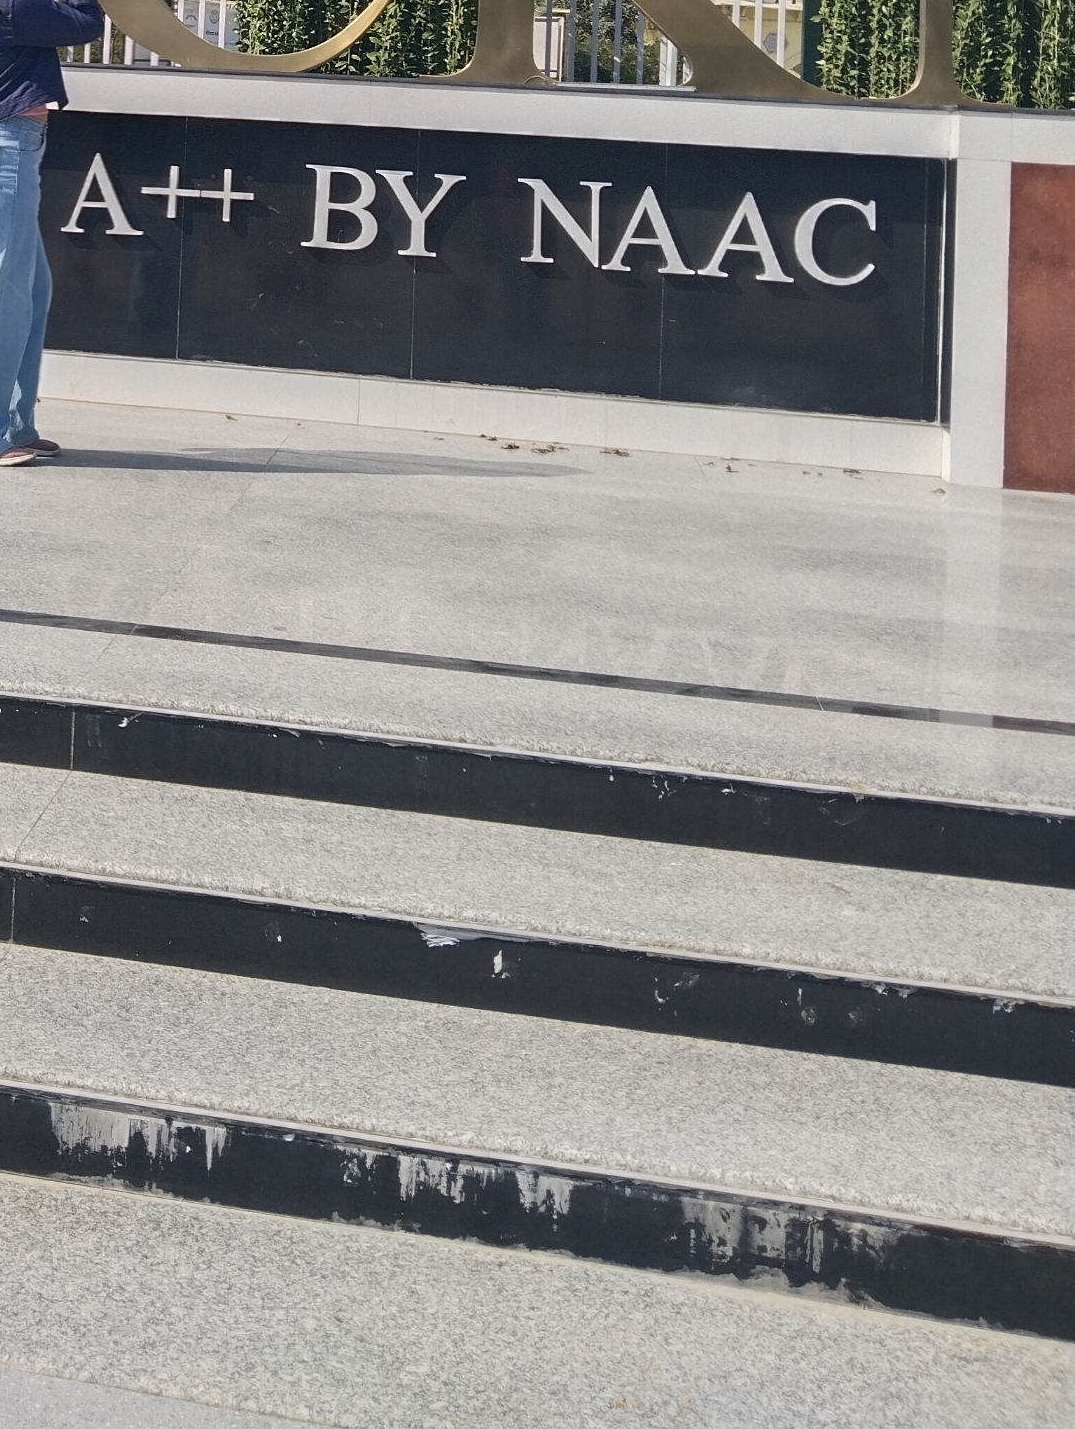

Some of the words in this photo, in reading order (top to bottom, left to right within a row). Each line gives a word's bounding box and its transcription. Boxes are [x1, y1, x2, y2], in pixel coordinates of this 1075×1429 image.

[59, 152, 255, 237] A++
[299, 163, 467, 260] BY
[517, 176, 879, 289] NAAC
